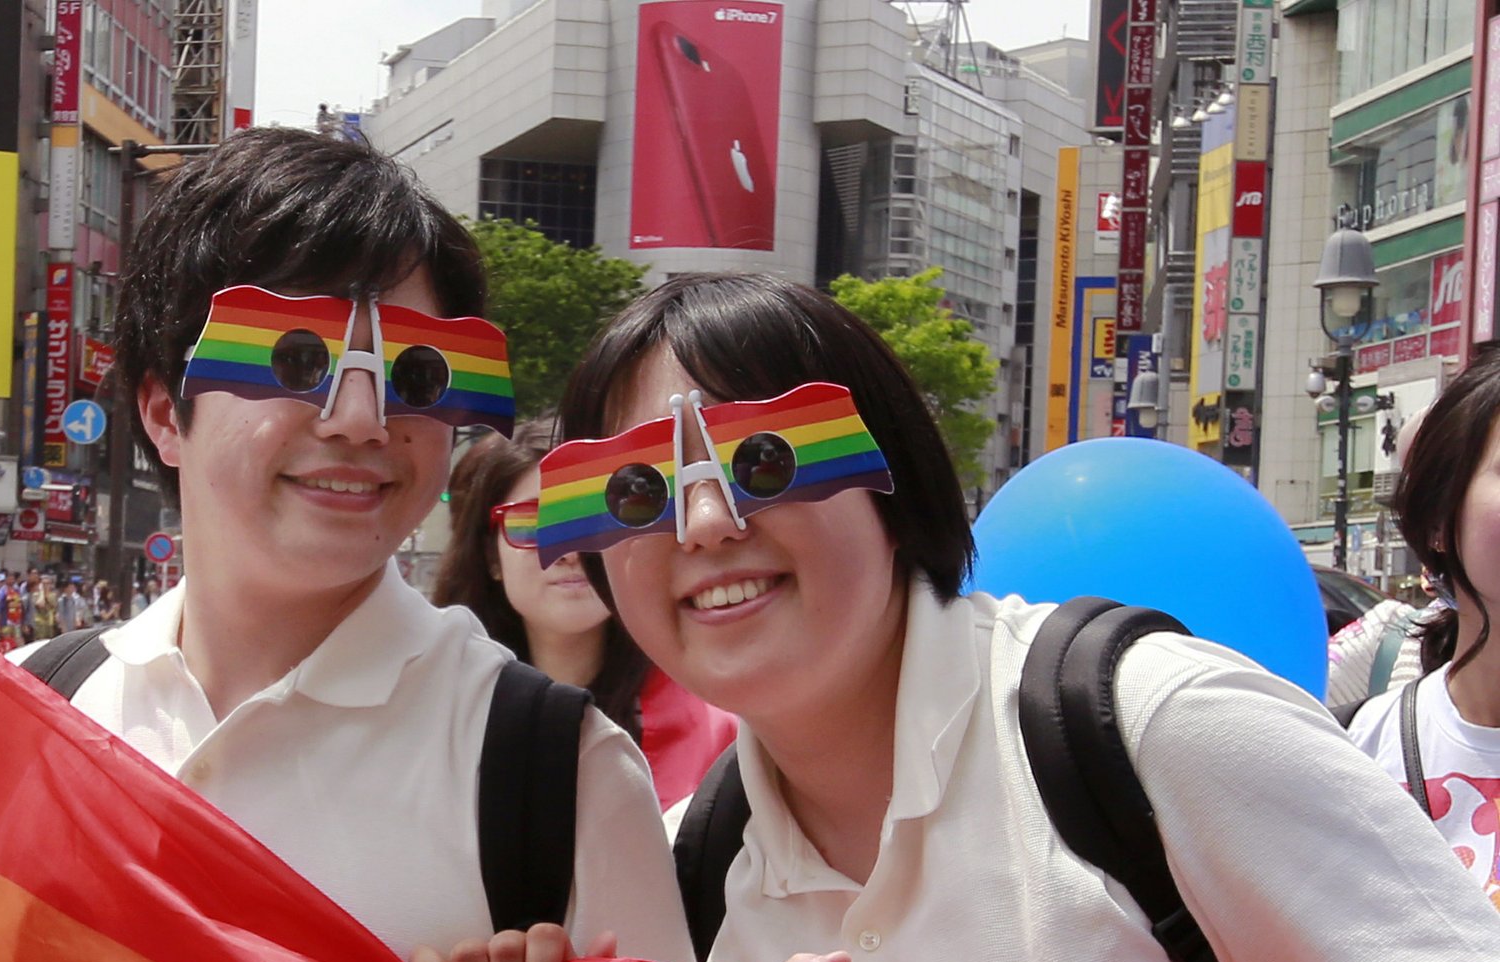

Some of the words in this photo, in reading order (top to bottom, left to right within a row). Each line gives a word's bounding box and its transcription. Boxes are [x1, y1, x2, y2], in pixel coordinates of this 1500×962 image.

[58, 2, 80, 14] 5F
[1235, 191, 1263, 207] JTB
[1055, 244, 1070, 329] Matsumoto
